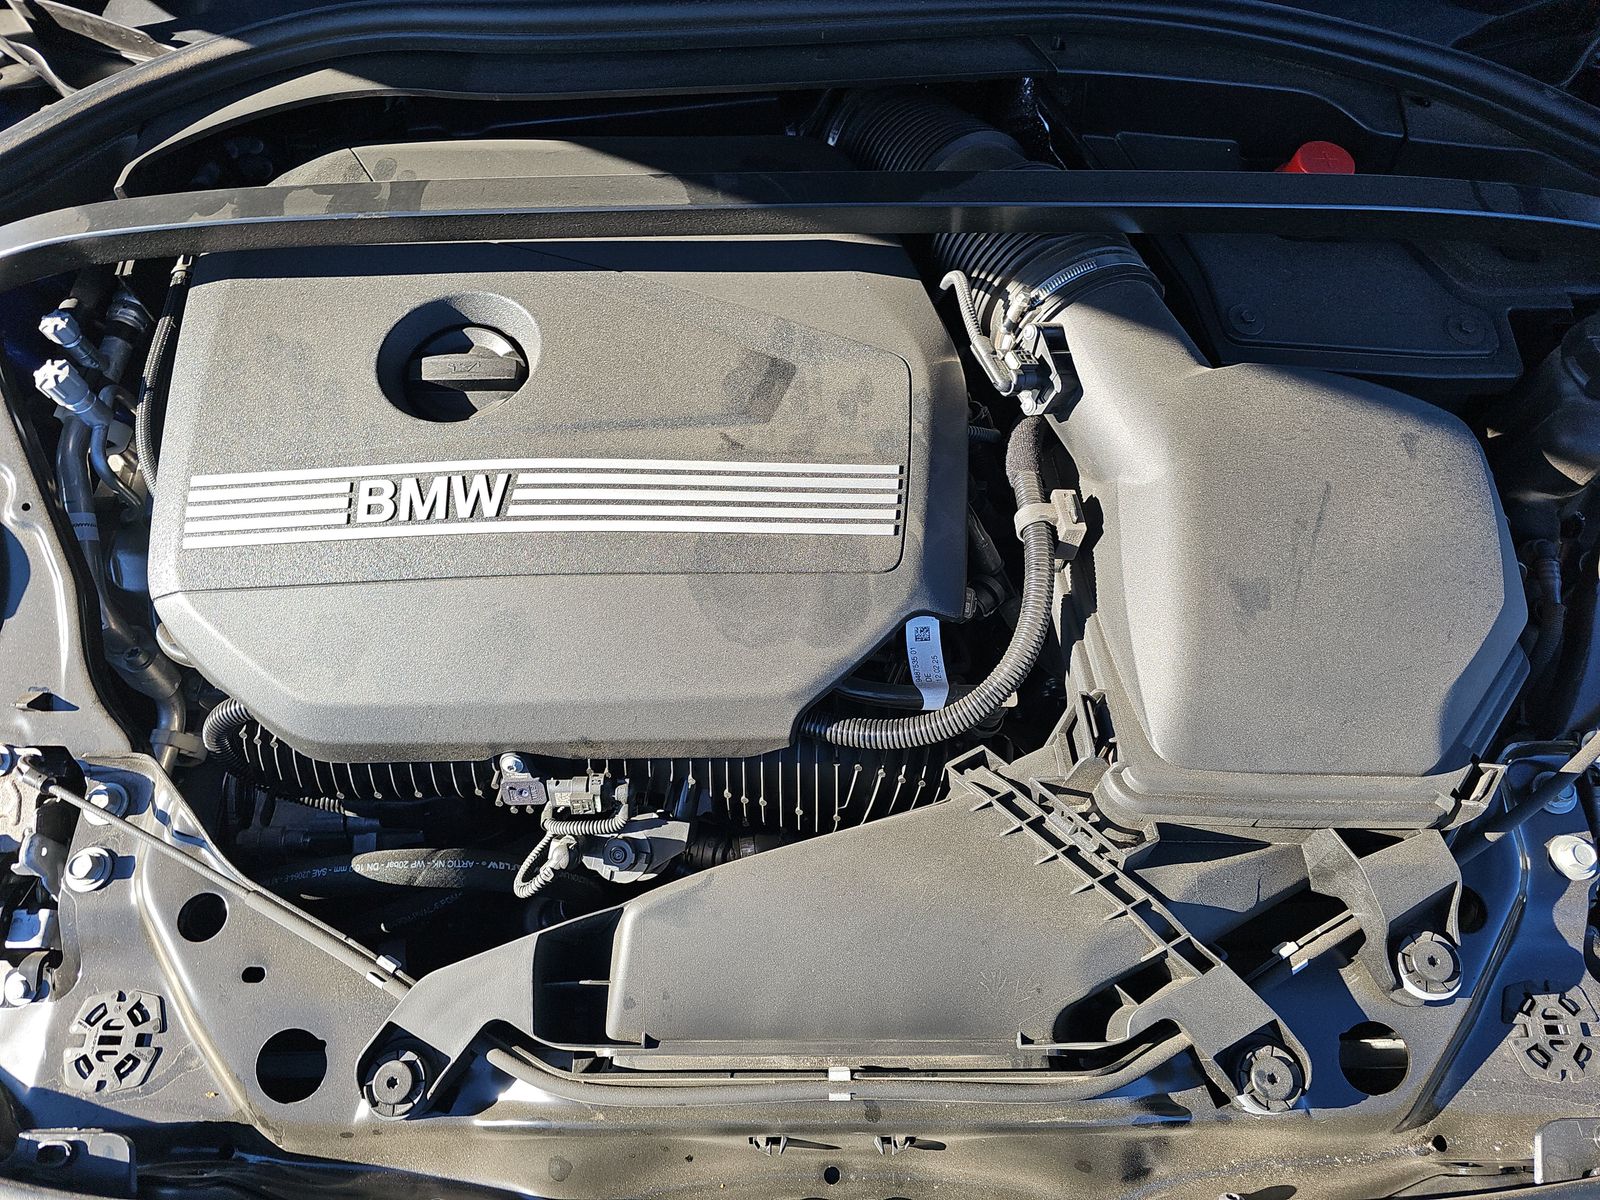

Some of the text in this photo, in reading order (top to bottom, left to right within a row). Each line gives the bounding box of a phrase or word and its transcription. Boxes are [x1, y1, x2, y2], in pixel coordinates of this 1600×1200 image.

[355, 473, 511, 524] BMW
[931, 655, 942, 682] 12.02.25
[924, 673, 932, 682] DE
[367, 862, 379, 871] DN
[410, 860, 425, 868] WP
[447, 859, 474, 868] ARTIC
[312, 867, 327, 877] SAE
